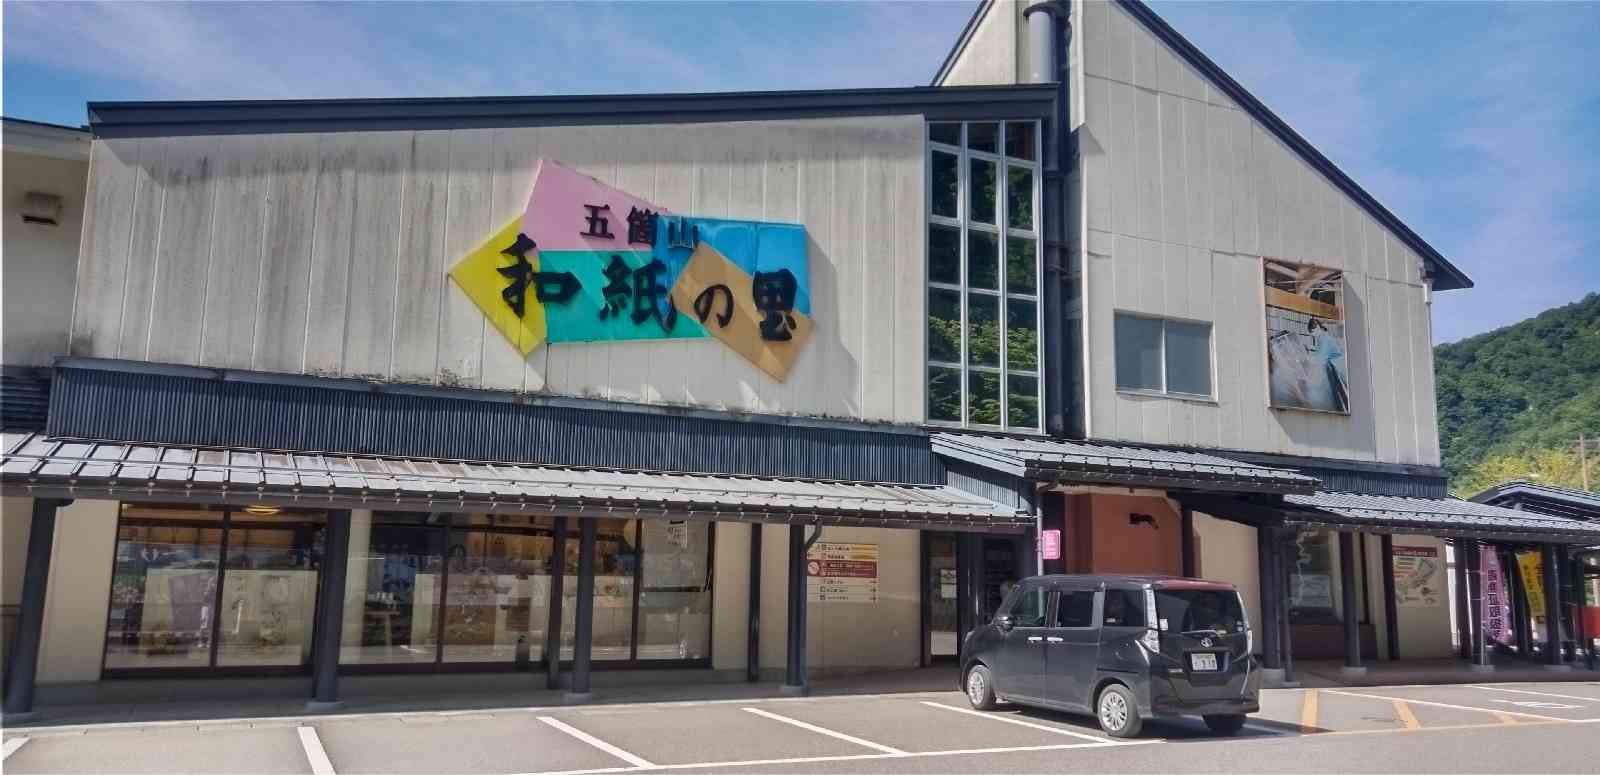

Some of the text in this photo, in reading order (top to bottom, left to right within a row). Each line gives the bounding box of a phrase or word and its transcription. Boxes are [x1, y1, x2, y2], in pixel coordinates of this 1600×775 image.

[580, 204, 699, 249] 五箇山
[497, 233, 798, 341] 和紙の里
